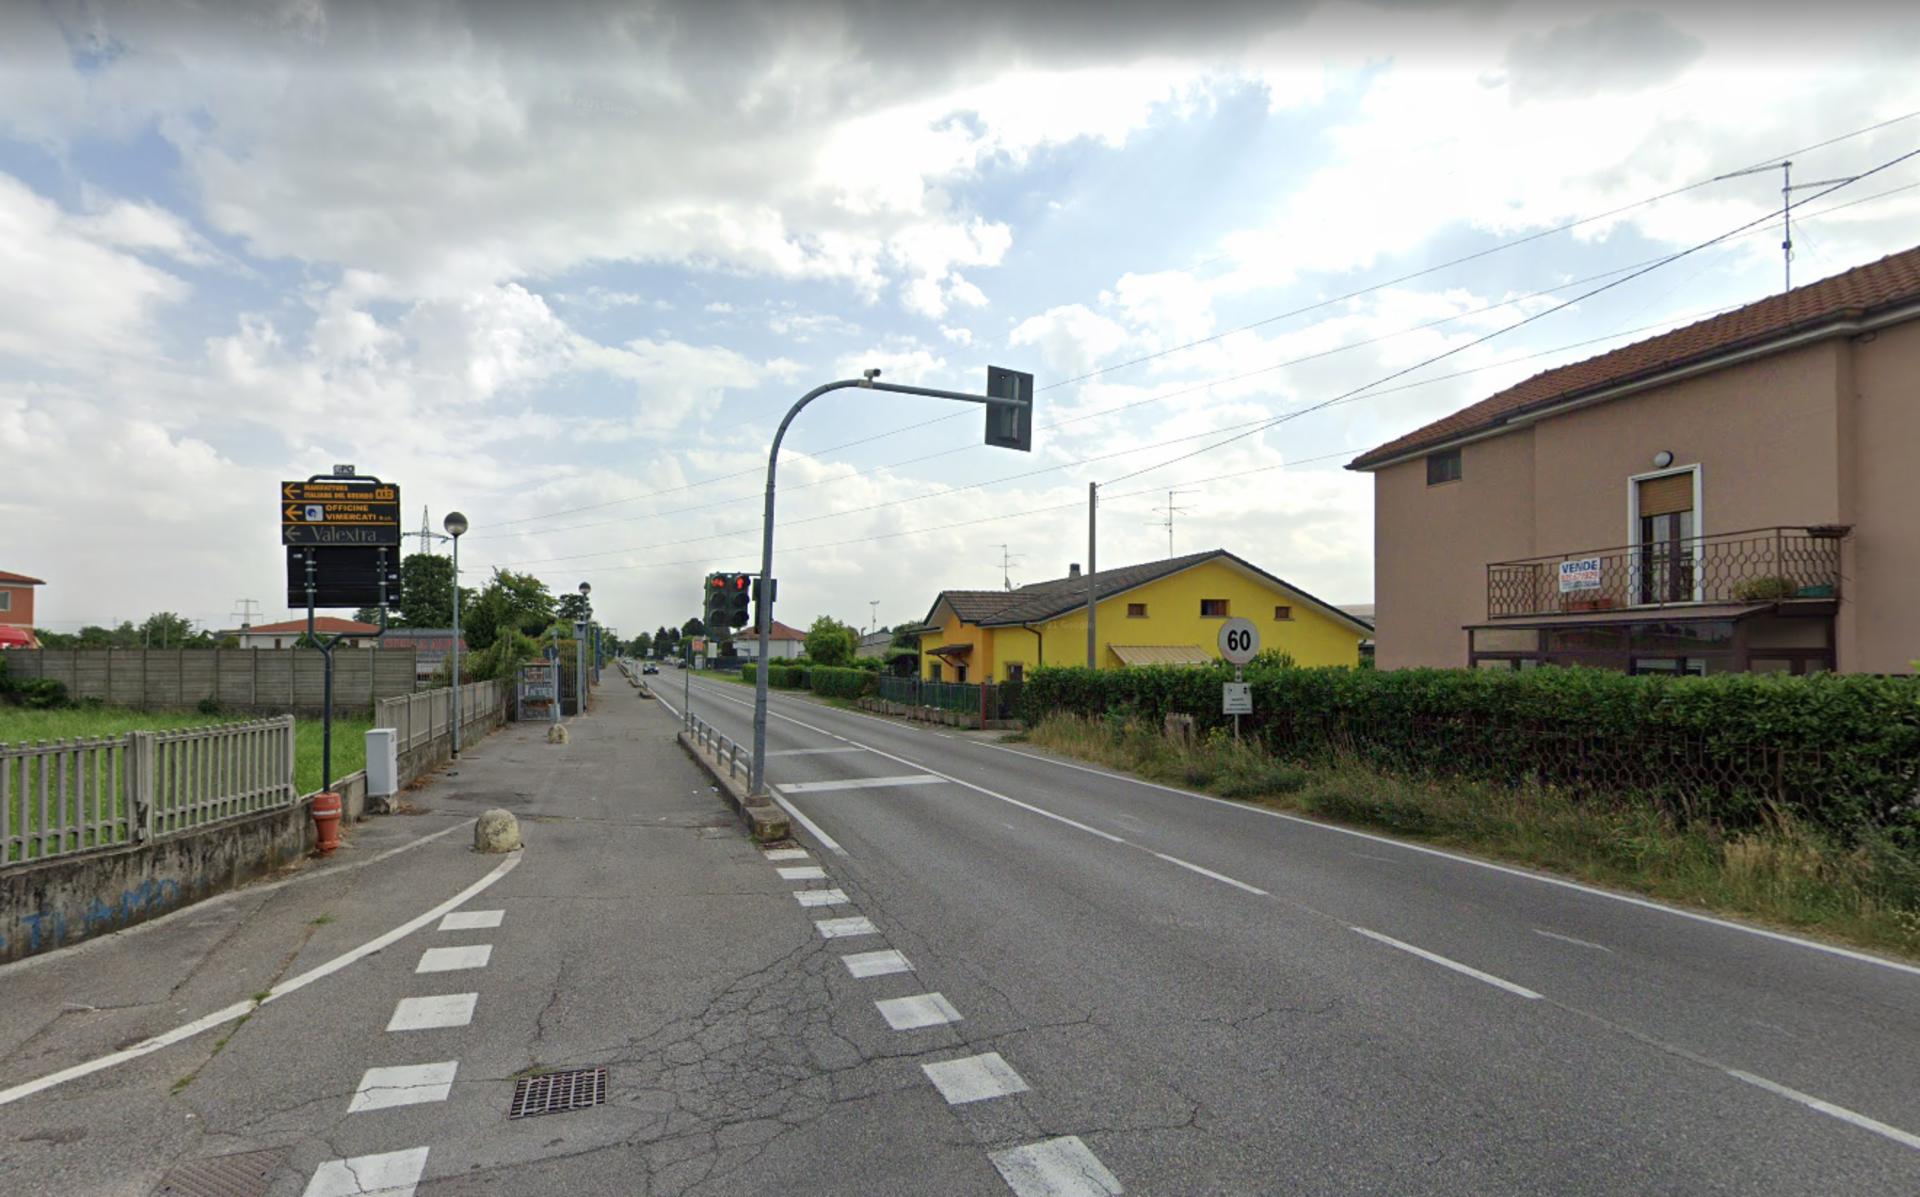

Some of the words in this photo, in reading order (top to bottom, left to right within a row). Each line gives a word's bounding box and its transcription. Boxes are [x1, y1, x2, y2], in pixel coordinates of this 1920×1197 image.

[311, 526, 376, 542] Valextra
[1562, 560, 1598, 573] VENDE
[1227, 629, 1251, 652] 60
